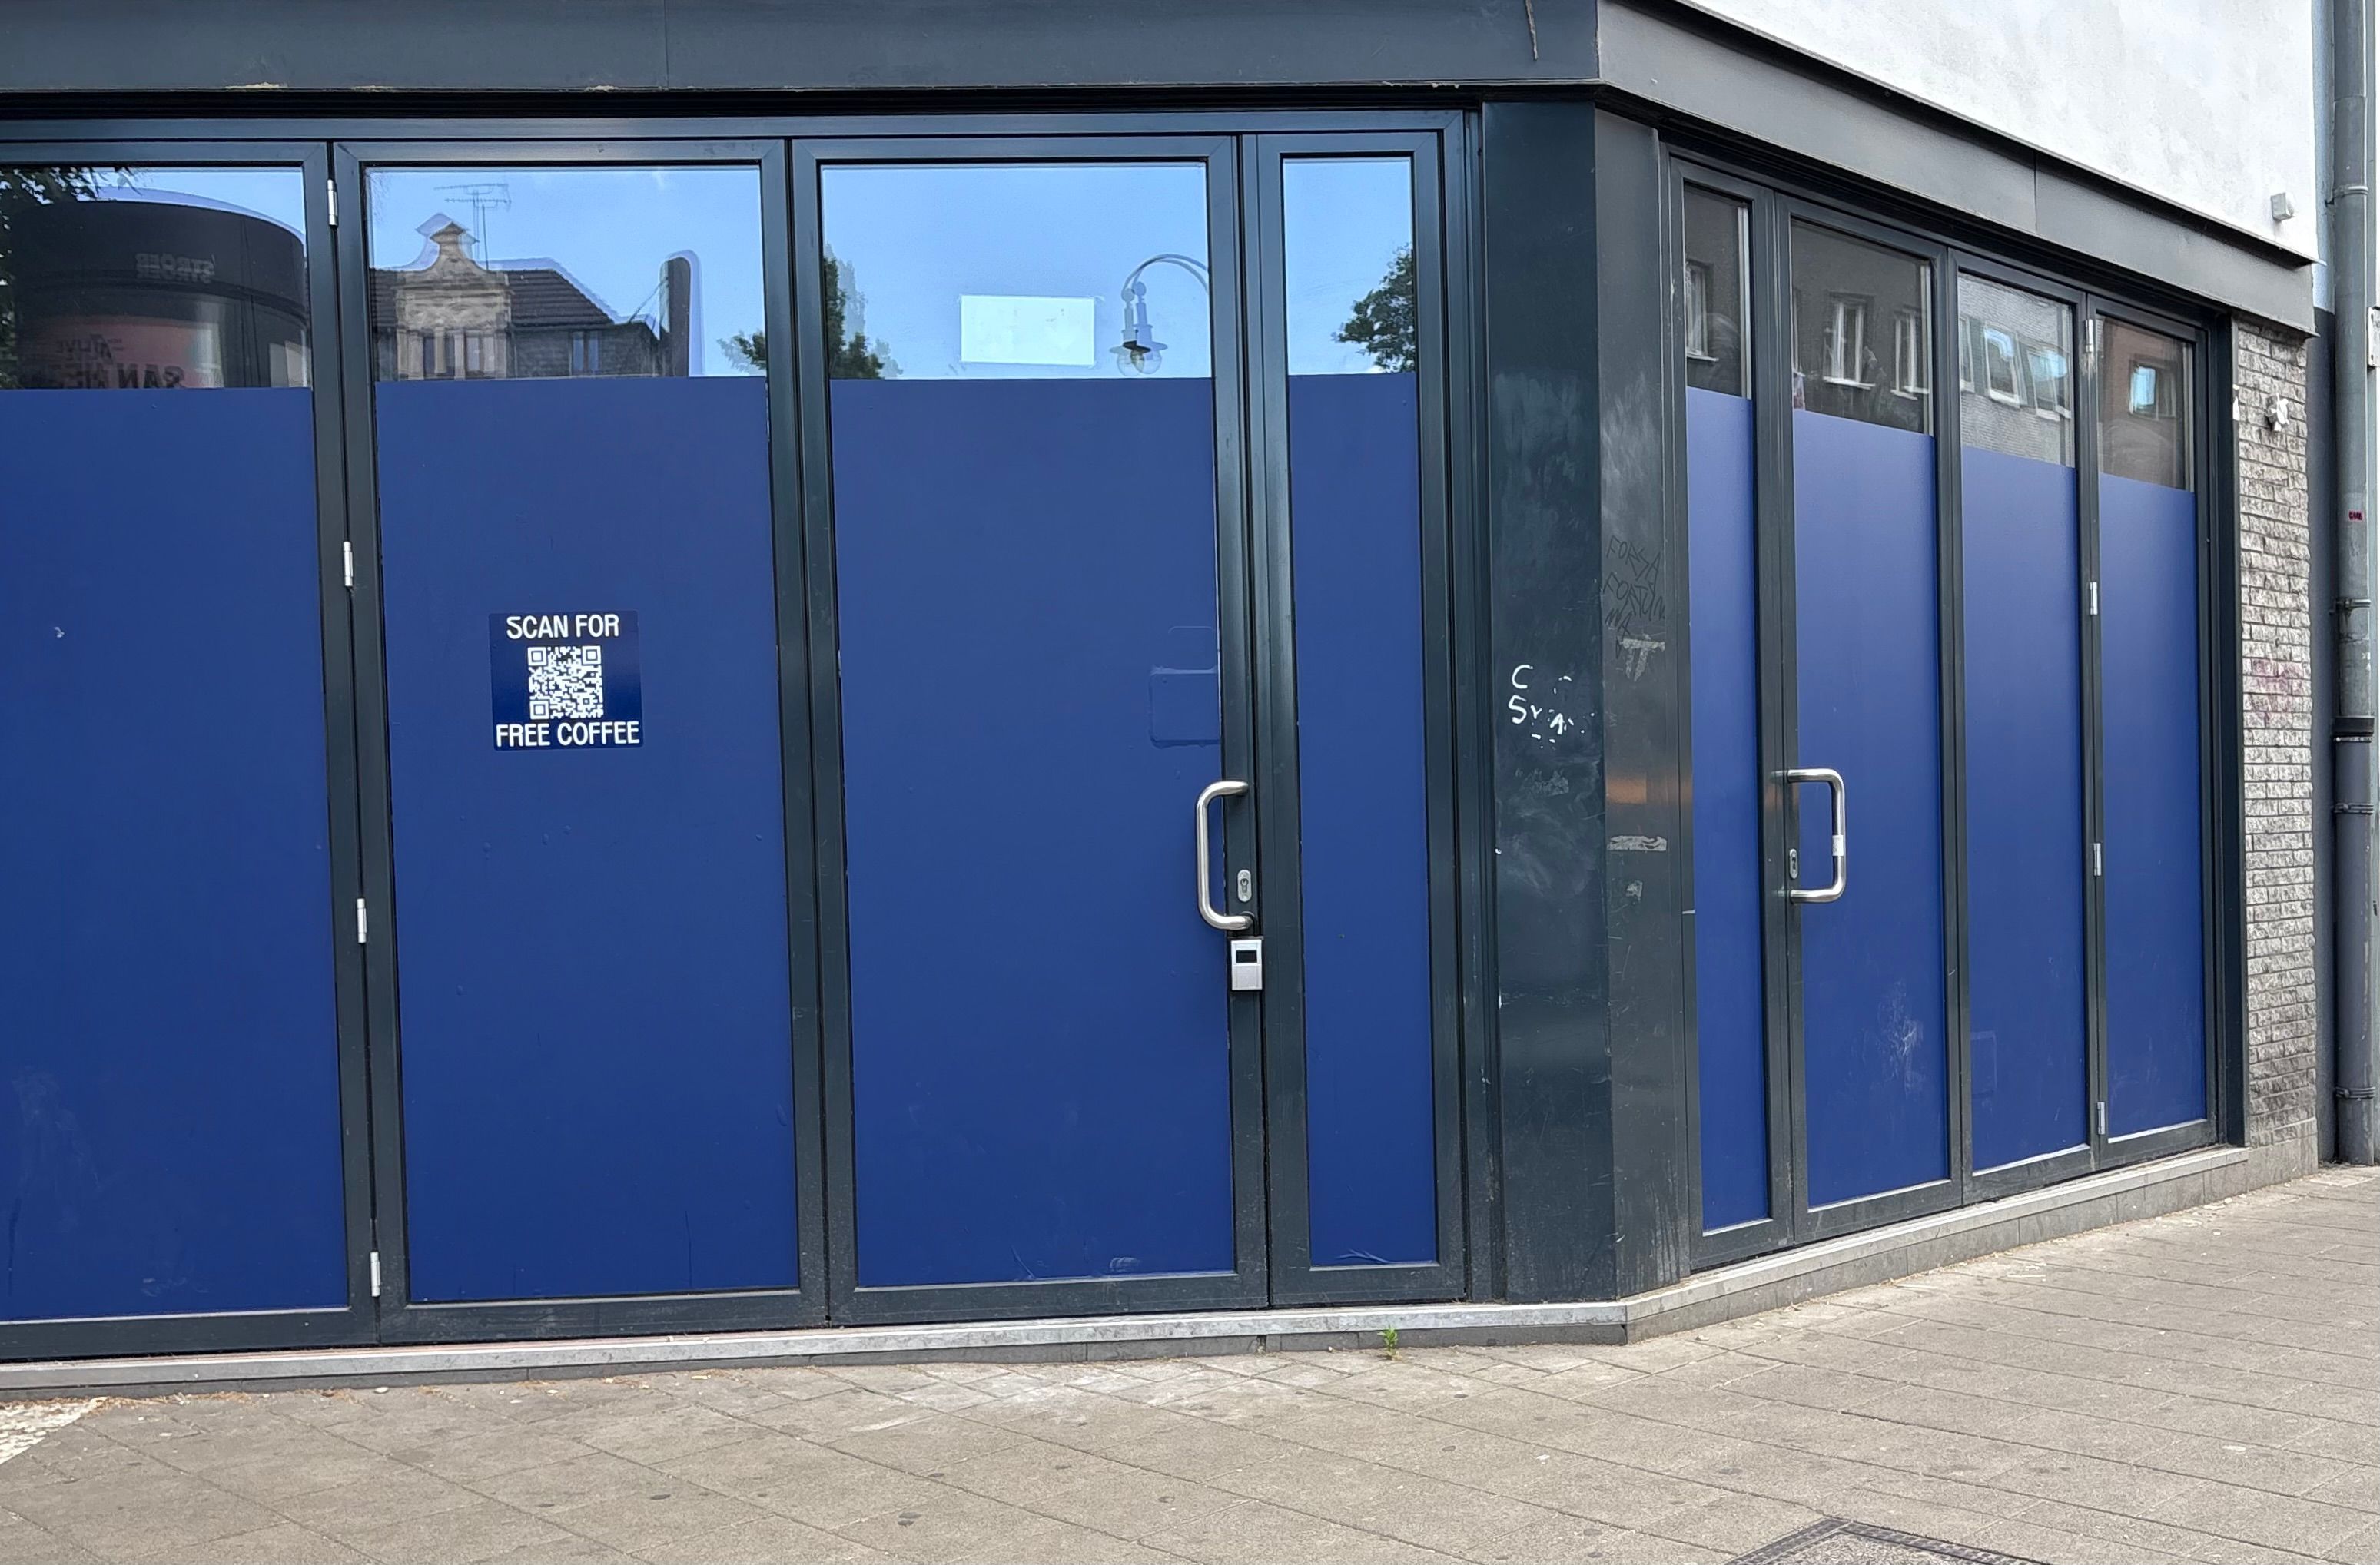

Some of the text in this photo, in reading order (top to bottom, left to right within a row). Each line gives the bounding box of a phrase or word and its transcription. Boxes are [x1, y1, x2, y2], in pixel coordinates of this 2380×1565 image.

[506, 614, 619, 639] SCAN FOR
[496, 721, 640, 747] FREE COFFEE
